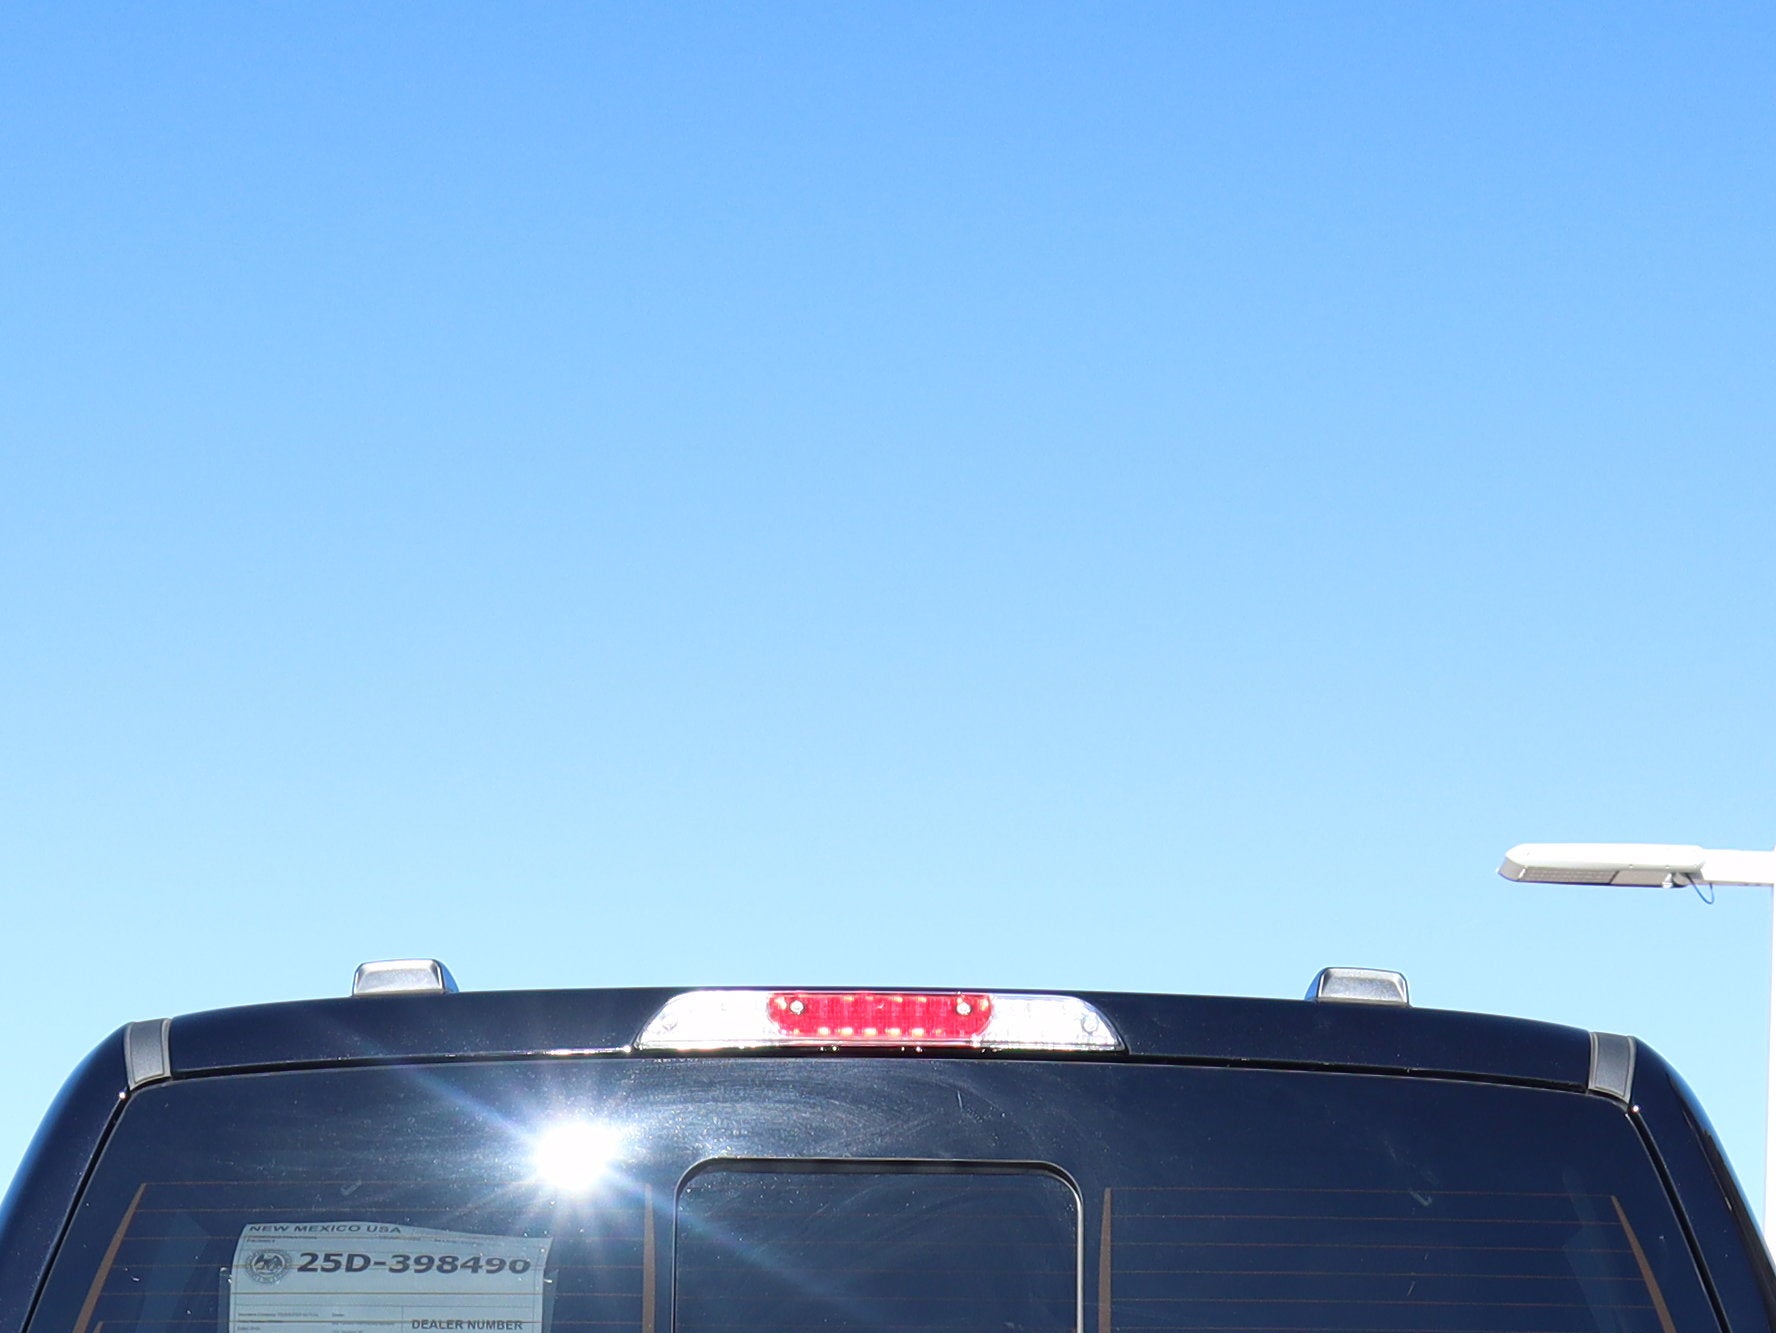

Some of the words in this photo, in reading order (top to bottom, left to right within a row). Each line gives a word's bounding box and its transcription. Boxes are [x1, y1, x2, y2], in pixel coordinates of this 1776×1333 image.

[366, 1226, 402, 1234] USA
[297, 1252, 531, 1274] 25D-398490
[411, 1319, 463, 1330] DEALER
[467, 1320, 523, 1330] NUMBER
